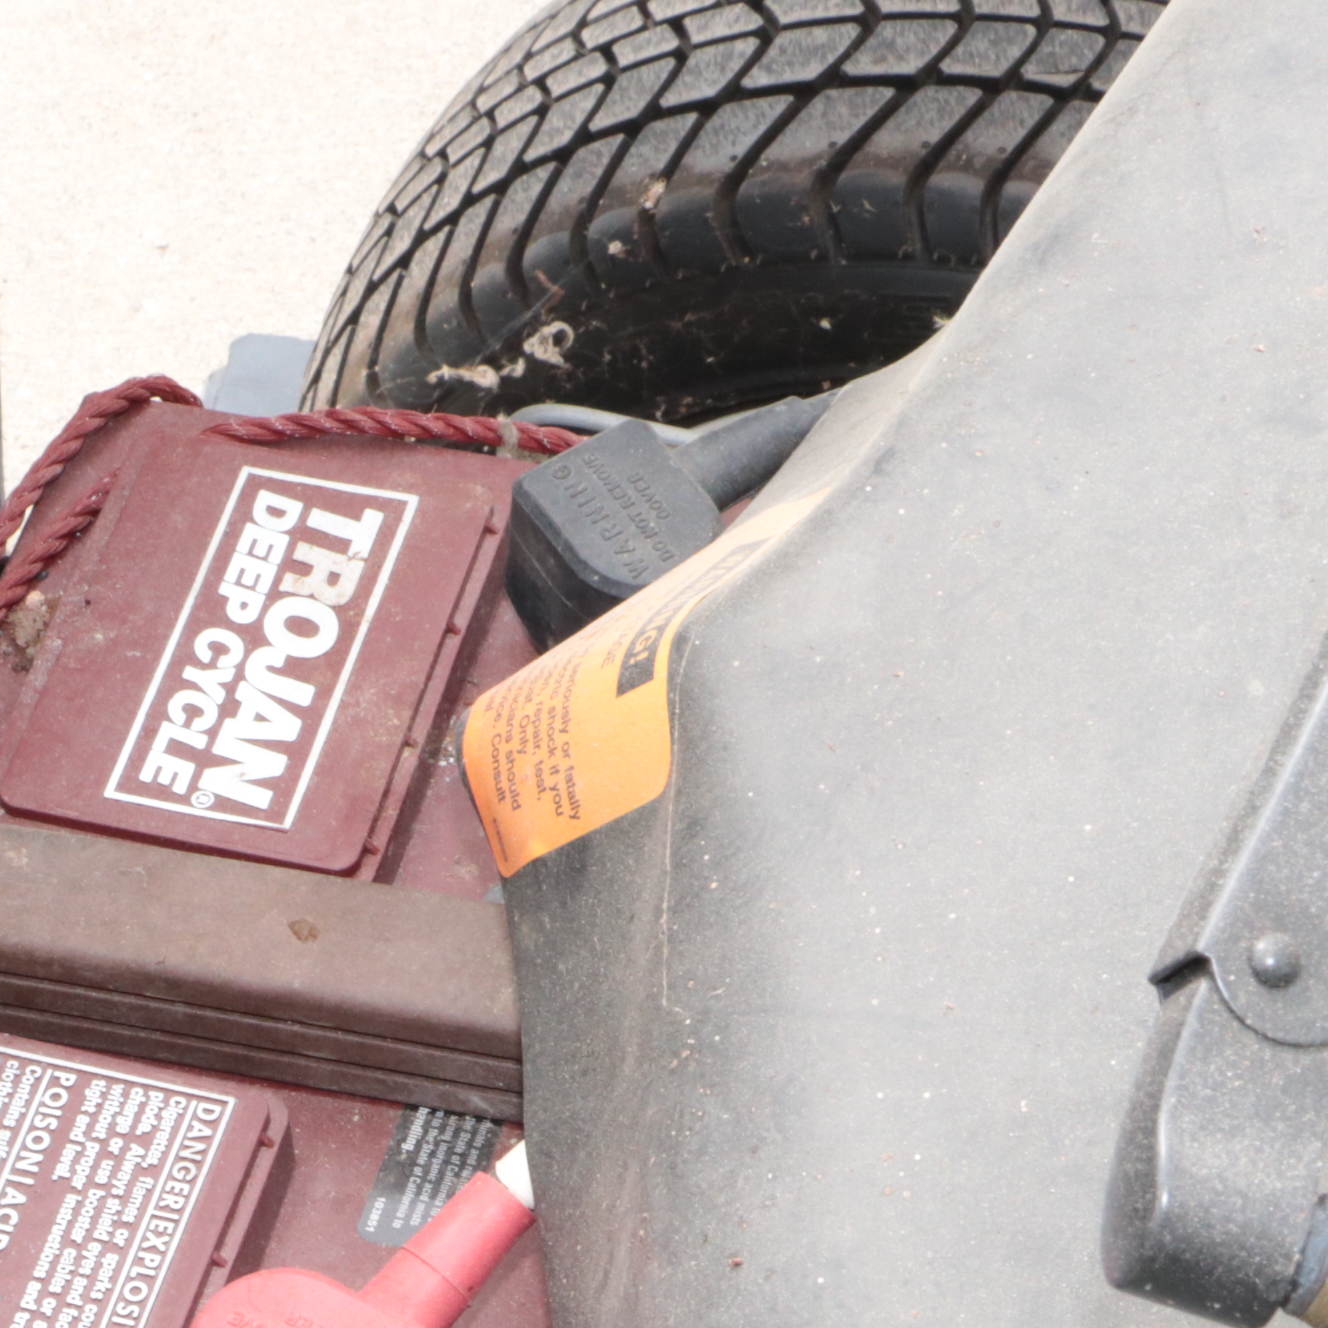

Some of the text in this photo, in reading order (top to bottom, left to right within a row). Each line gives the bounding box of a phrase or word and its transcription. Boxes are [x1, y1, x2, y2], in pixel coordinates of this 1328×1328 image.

[627, 471, 671, 519] COVER
[552, 464, 649, 578] WARNING
[626, 511, 658, 538] NOT
[219, 490, 304, 625] DEEP
[652, 540, 674, 562] DO
[200, 508, 384, 811] TROJAN
[517, 715, 530, 754] Only
[532, 701, 543, 755] repair,
[547, 706, 557, 758] shock
[492, 733, 506, 803] Consult
[549, 764, 560, 775] if
[562, 742, 570, 758] or
[506, 750, 521, 811] should
[535, 760, 546, 800] test,
[549, 782, 564, 817] you
[565, 765, 581, 819] fatally
[2, 1065, 42, 1127] Contains
[91, 1084, 124, 1139] without
[115, 1087, 146, 1134] charge
[135, 1091, 164, 1135] plode.
[14, 1071, 77, 1172] POISON
[51, 1080, 107, 1180] tight and level.
[141, 1096, 187, 1168] Cigarettes,
[401, 1107, 431, 1153] handling.
[426, 1128, 438, 1142] the
[431, 1118, 442, 1126] to
[454, 1131, 471, 1154] State
[71, 1141, 100, 1190] proper
[107, 1137, 123, 1155] or
[158, 1102, 222, 1209] DANGER
[416, 1143, 434, 1165] State
[427, 1142, 451, 1182] inorganic
[451, 1154, 460, 1165] of
[94, 1160, 114, 1184] use
[110, 1143, 145, 1196] Always
[413, 1166, 423, 1176] of
[434, 1165, 458, 1206] California
[121, 1177, 154, 1223] flames
[396, 1176, 421, 1218] California
[420, 1182, 433, 1202] acid
[70, 1189, 106, 1244] booster
[92, 1197, 122, 1241] shield
[365, 1197, 386, 1232] 103851
[392, 1219, 404, 1228] to
[410, 1202, 425, 1226] mists
[32, 1193, 82, 1278] instructions
[112, 1229, 129, 1247] or
[48, 1248, 77, 1293] cables
[78, 1242, 102, 1275] eyes
[89, 1253, 119, 1299] sparks
[20, 1281, 42, 1310] and
[39, 1297, 57, 1316] or
[66, 1276, 87, 1306] and
